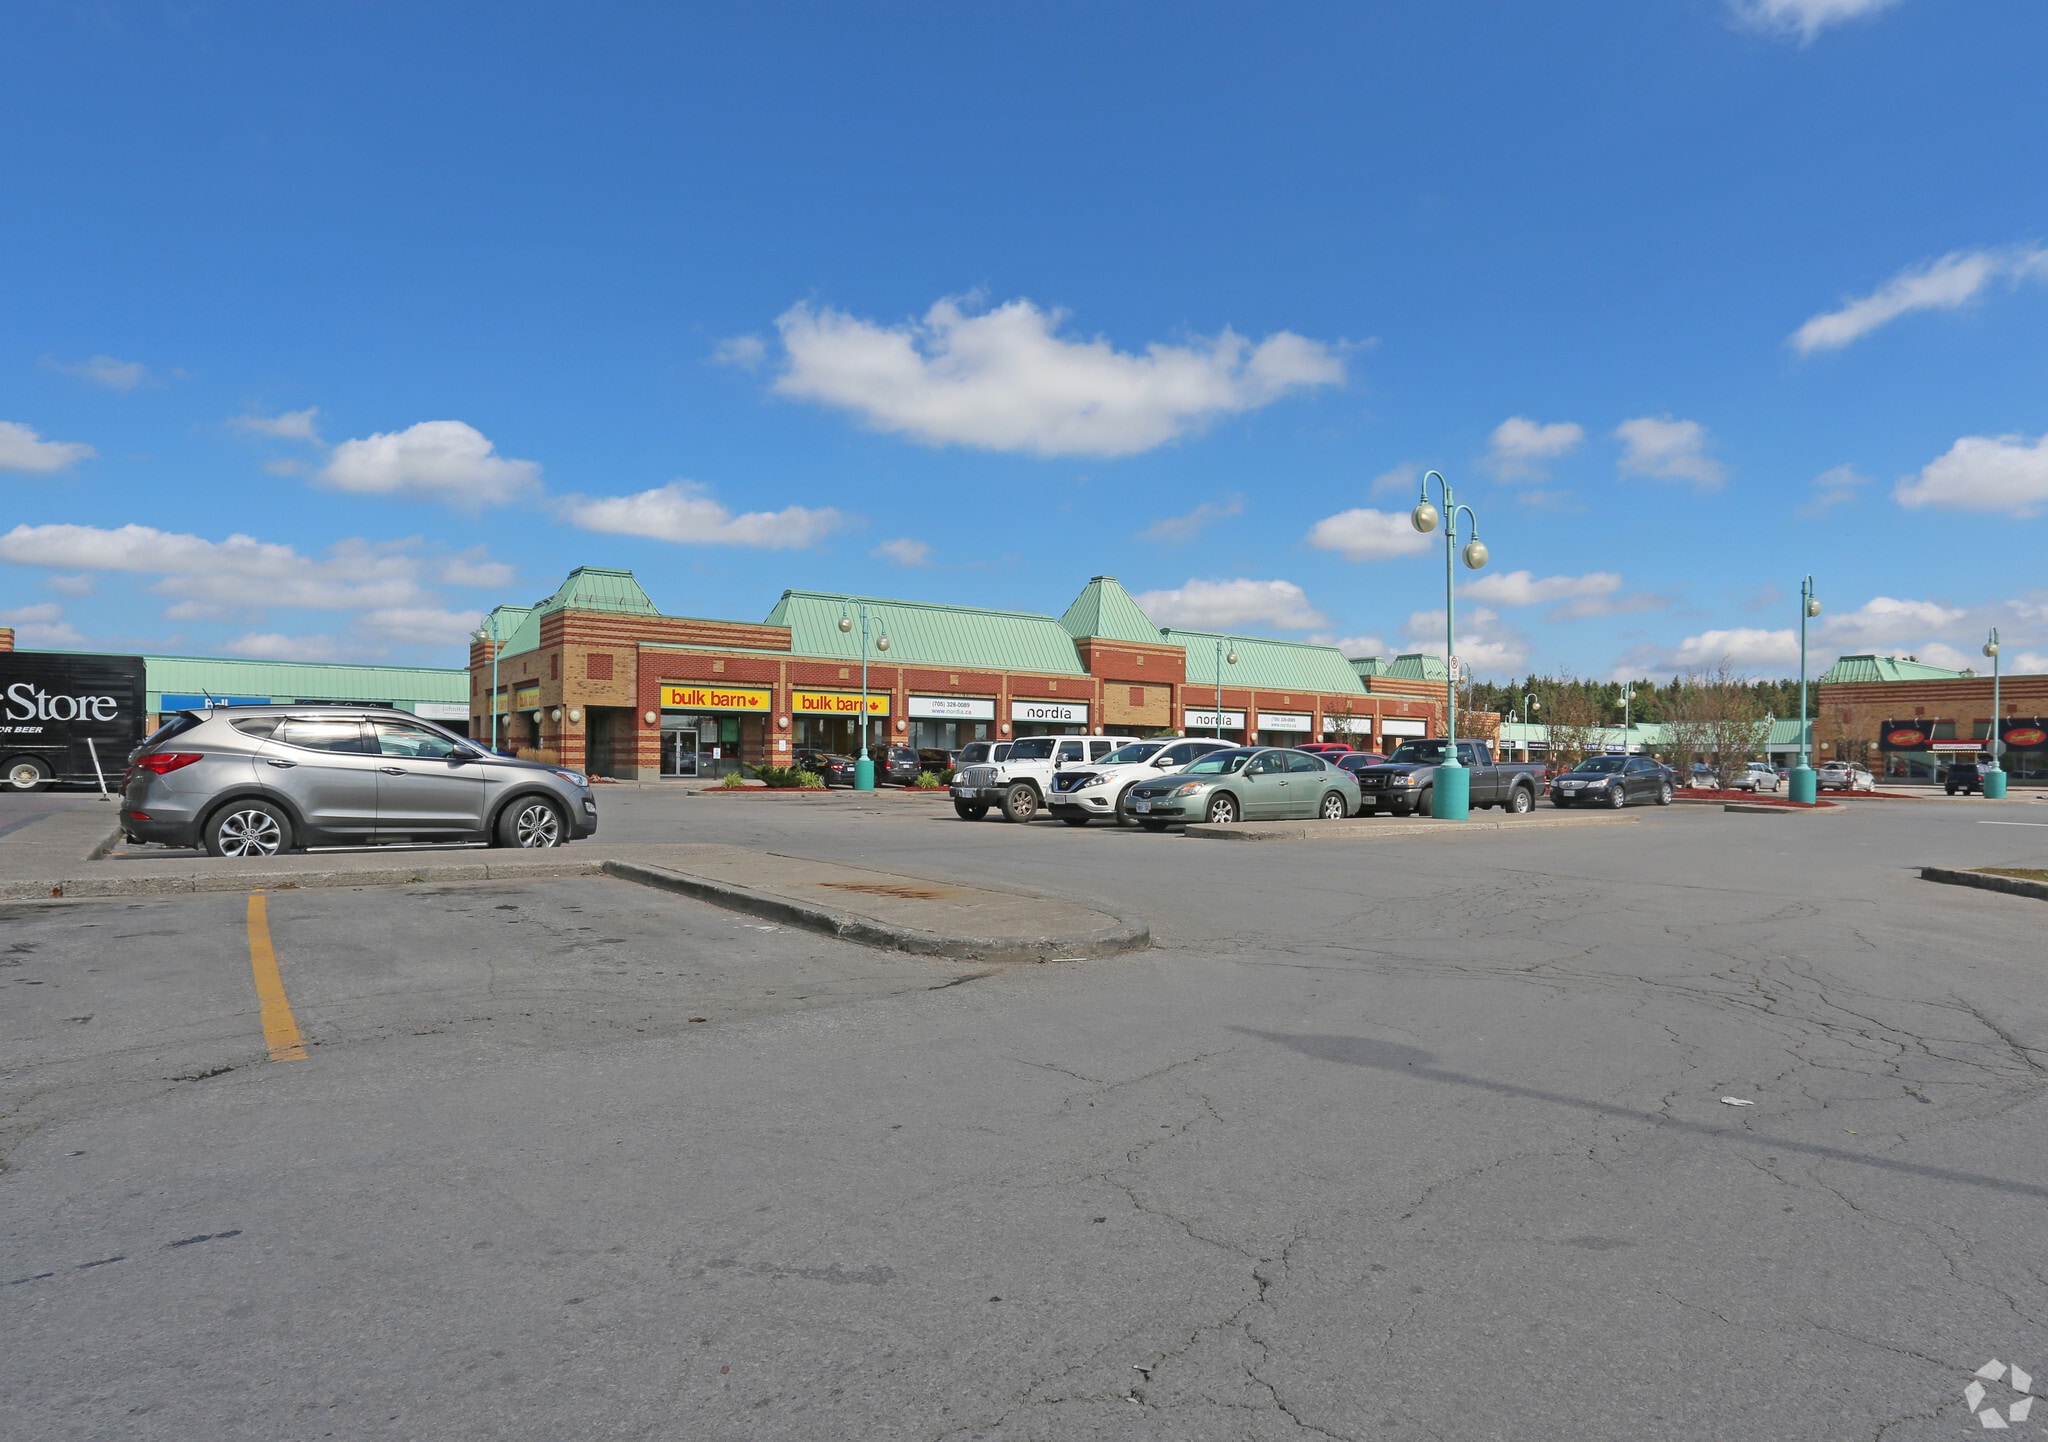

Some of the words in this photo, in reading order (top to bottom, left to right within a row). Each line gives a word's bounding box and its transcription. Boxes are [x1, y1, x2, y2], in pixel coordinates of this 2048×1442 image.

[6, 683, 118, 721] Store
[672, 689, 706, 706] bulk
[711, 691, 746, 707] barn
[802, 694, 832, 710] bulk
[1027, 706, 1072, 719] nordia
